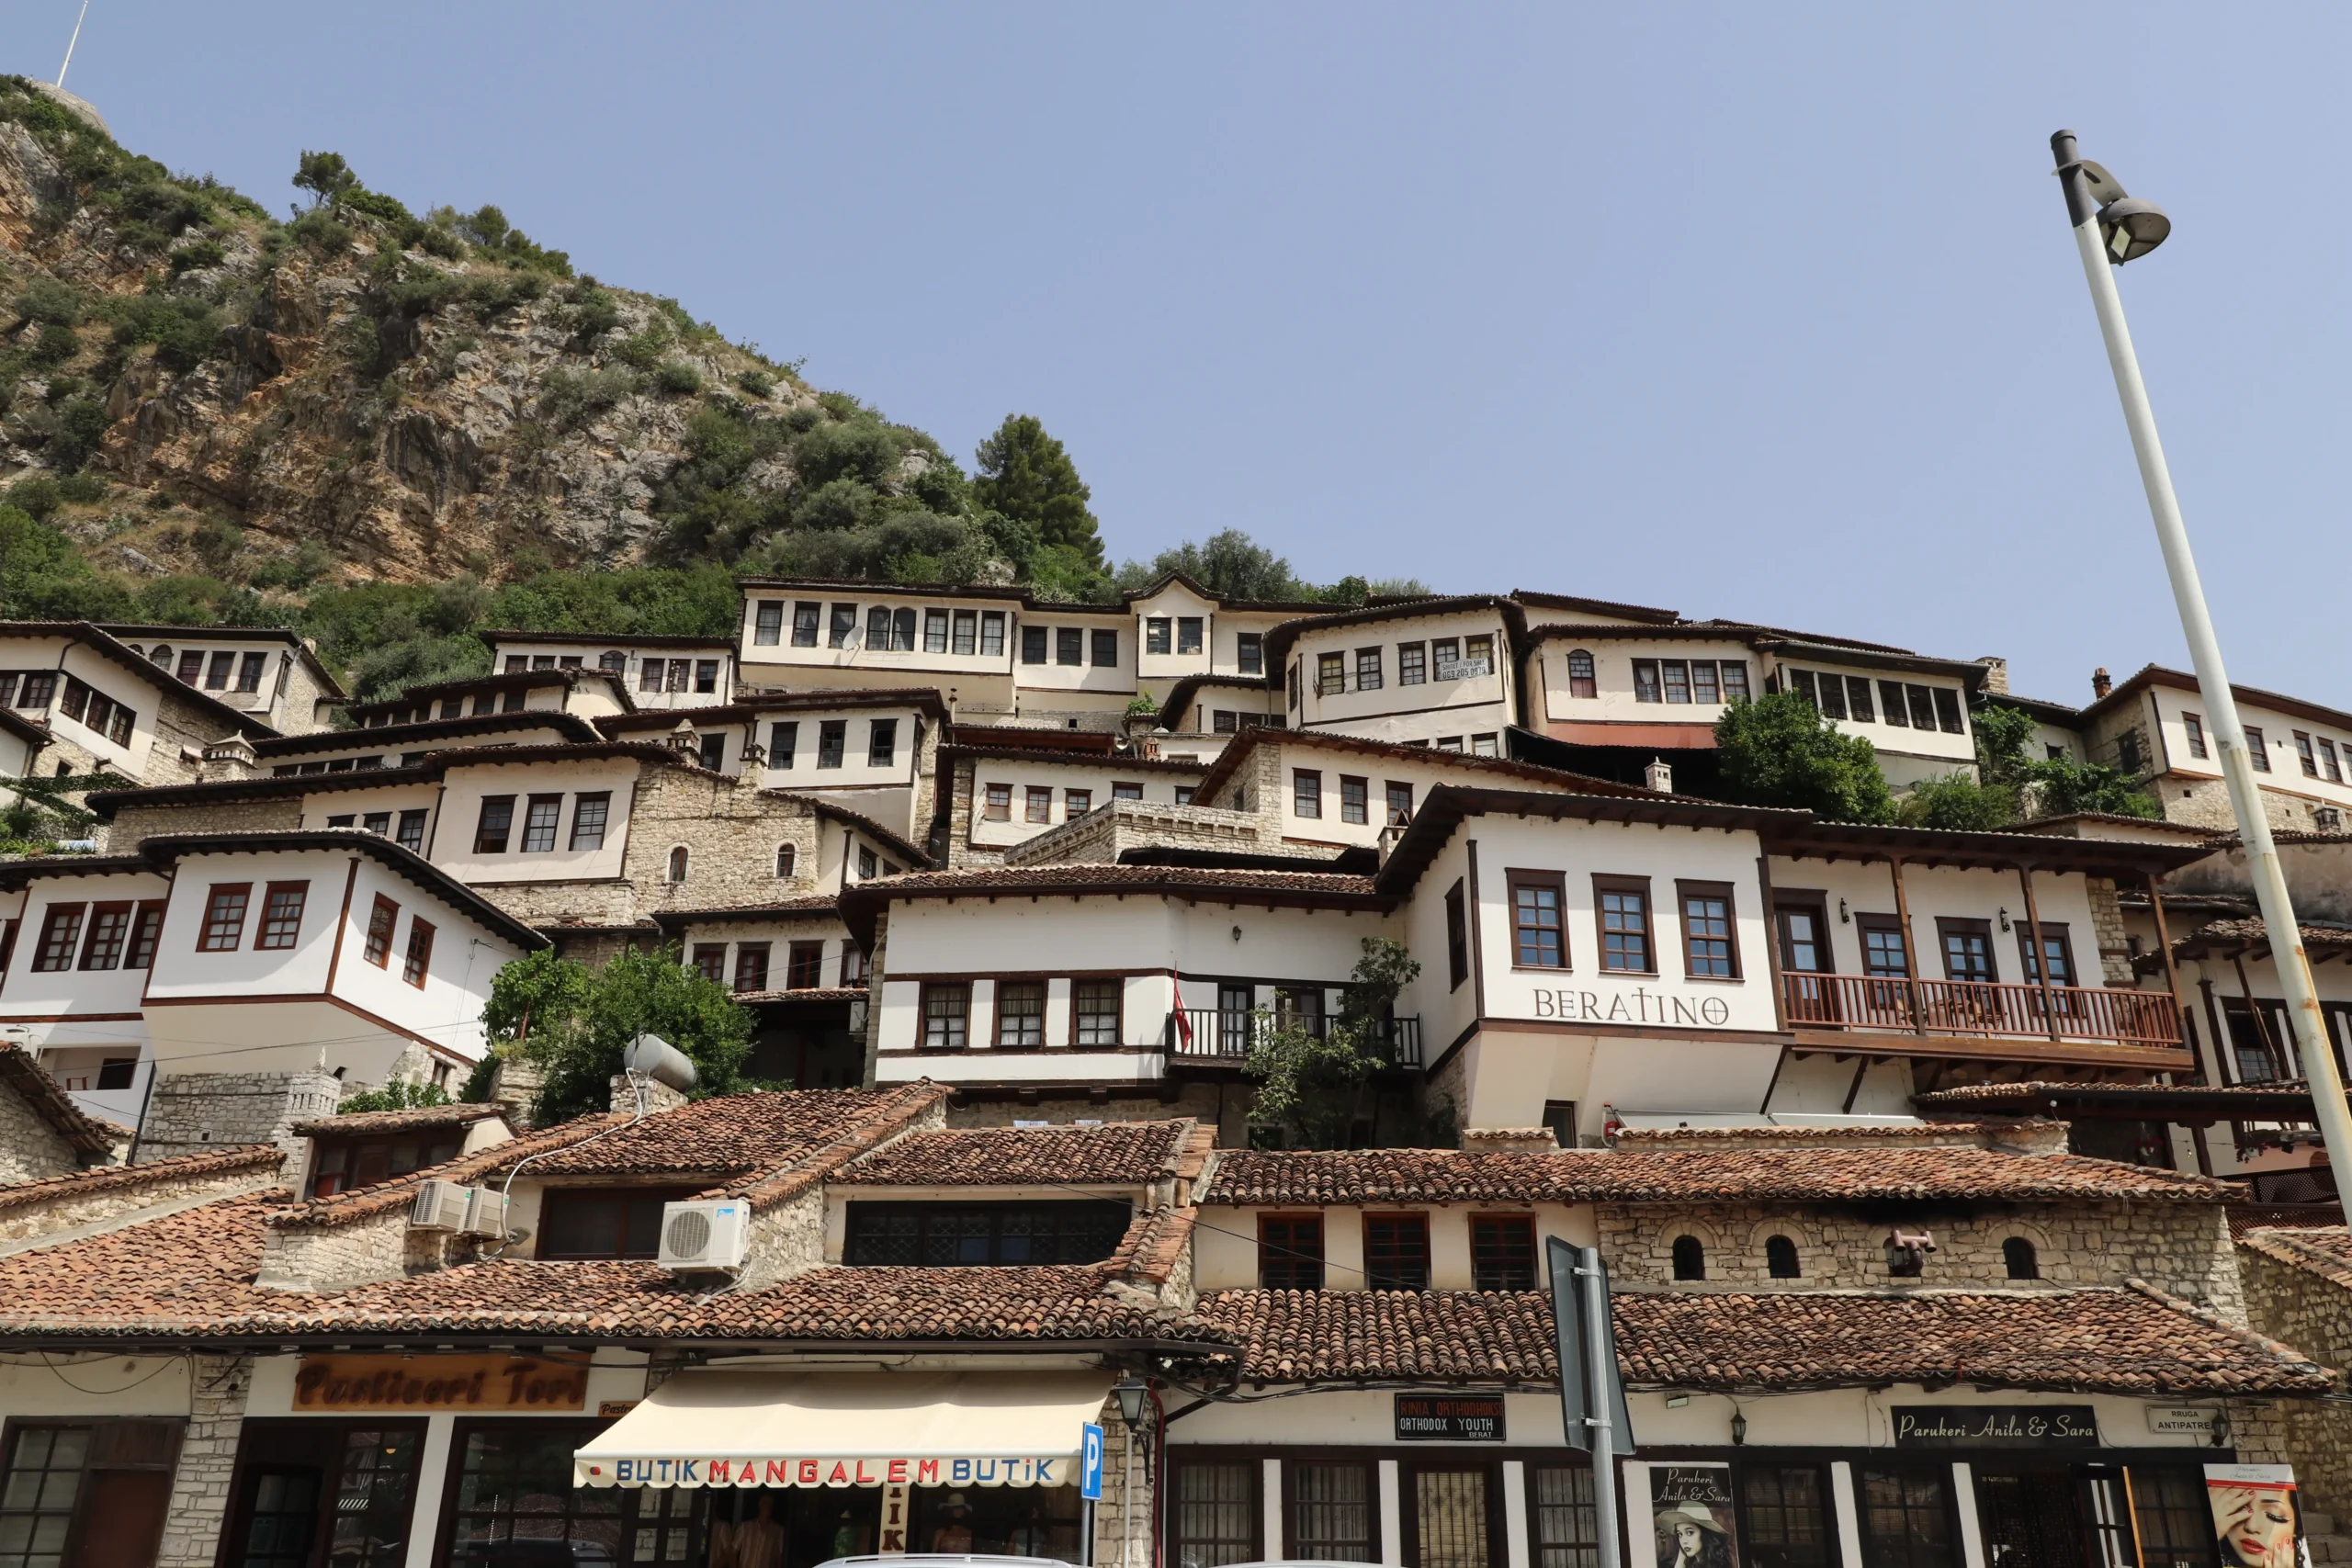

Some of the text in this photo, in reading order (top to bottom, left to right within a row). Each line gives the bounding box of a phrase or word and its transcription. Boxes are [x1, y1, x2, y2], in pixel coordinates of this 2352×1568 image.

[1442, 671, 1455, 679] 069
[1457, 669, 1469, 677] 205
[1532, 987, 1729, 1025] BERATINO
[503, 1361, 589, 1404] Tori
[1400, 1402, 1430, 1416] RINIA
[1400, 1417, 1493, 1431] ORTHODOX YOUTH
[1899, 1415, 2094, 1439] Parukeri Anila & Sara
[2158, 1421, 2213, 1430] ANTIPATRE
[1086, 1432, 1099, 1490] P
[708, 1460, 939, 1483] MANGALEM
[1667, 1468, 1713, 1485] Parukeri
[1653, 1485, 1731, 1503] Anila & Sara
